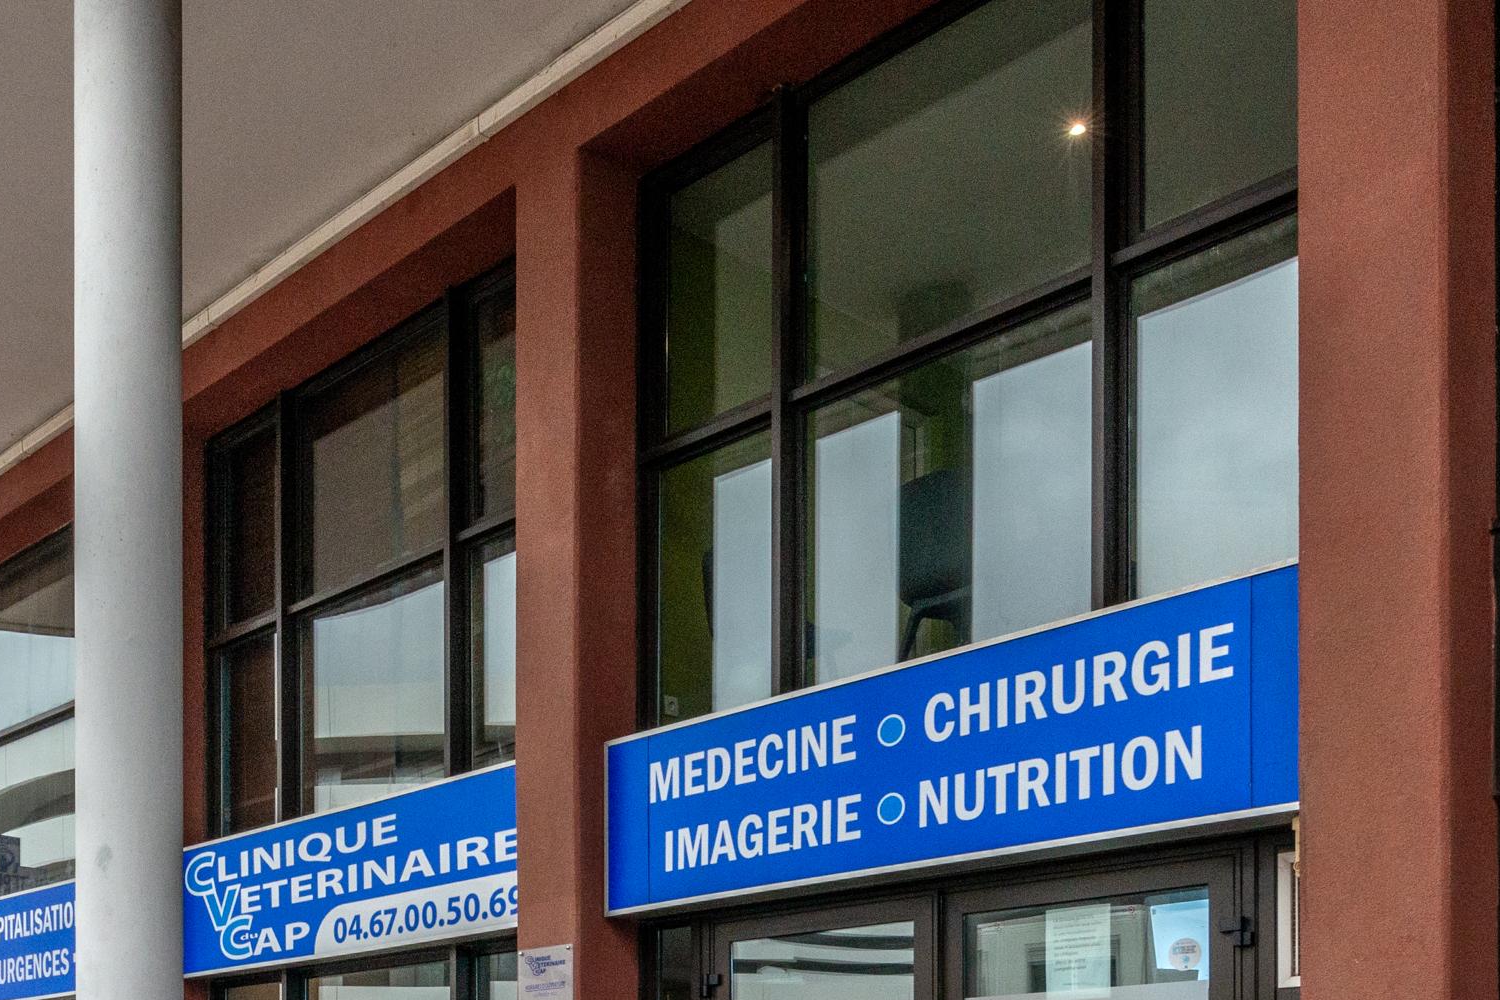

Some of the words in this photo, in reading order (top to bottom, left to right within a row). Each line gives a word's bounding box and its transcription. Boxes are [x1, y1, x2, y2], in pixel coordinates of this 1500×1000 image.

[648, 714, 857, 803] MEDECINE
[924, 622, 1235, 743] CHIRURGIE
[664, 793, 862, 872] IMAGERIE
[918, 725, 1203, 828] NUTRITION
[185, 813, 398, 896] CLINIQUE
[203, 828, 517, 931] VETERINAIRE
[220, 914, 310, 960] CAP
